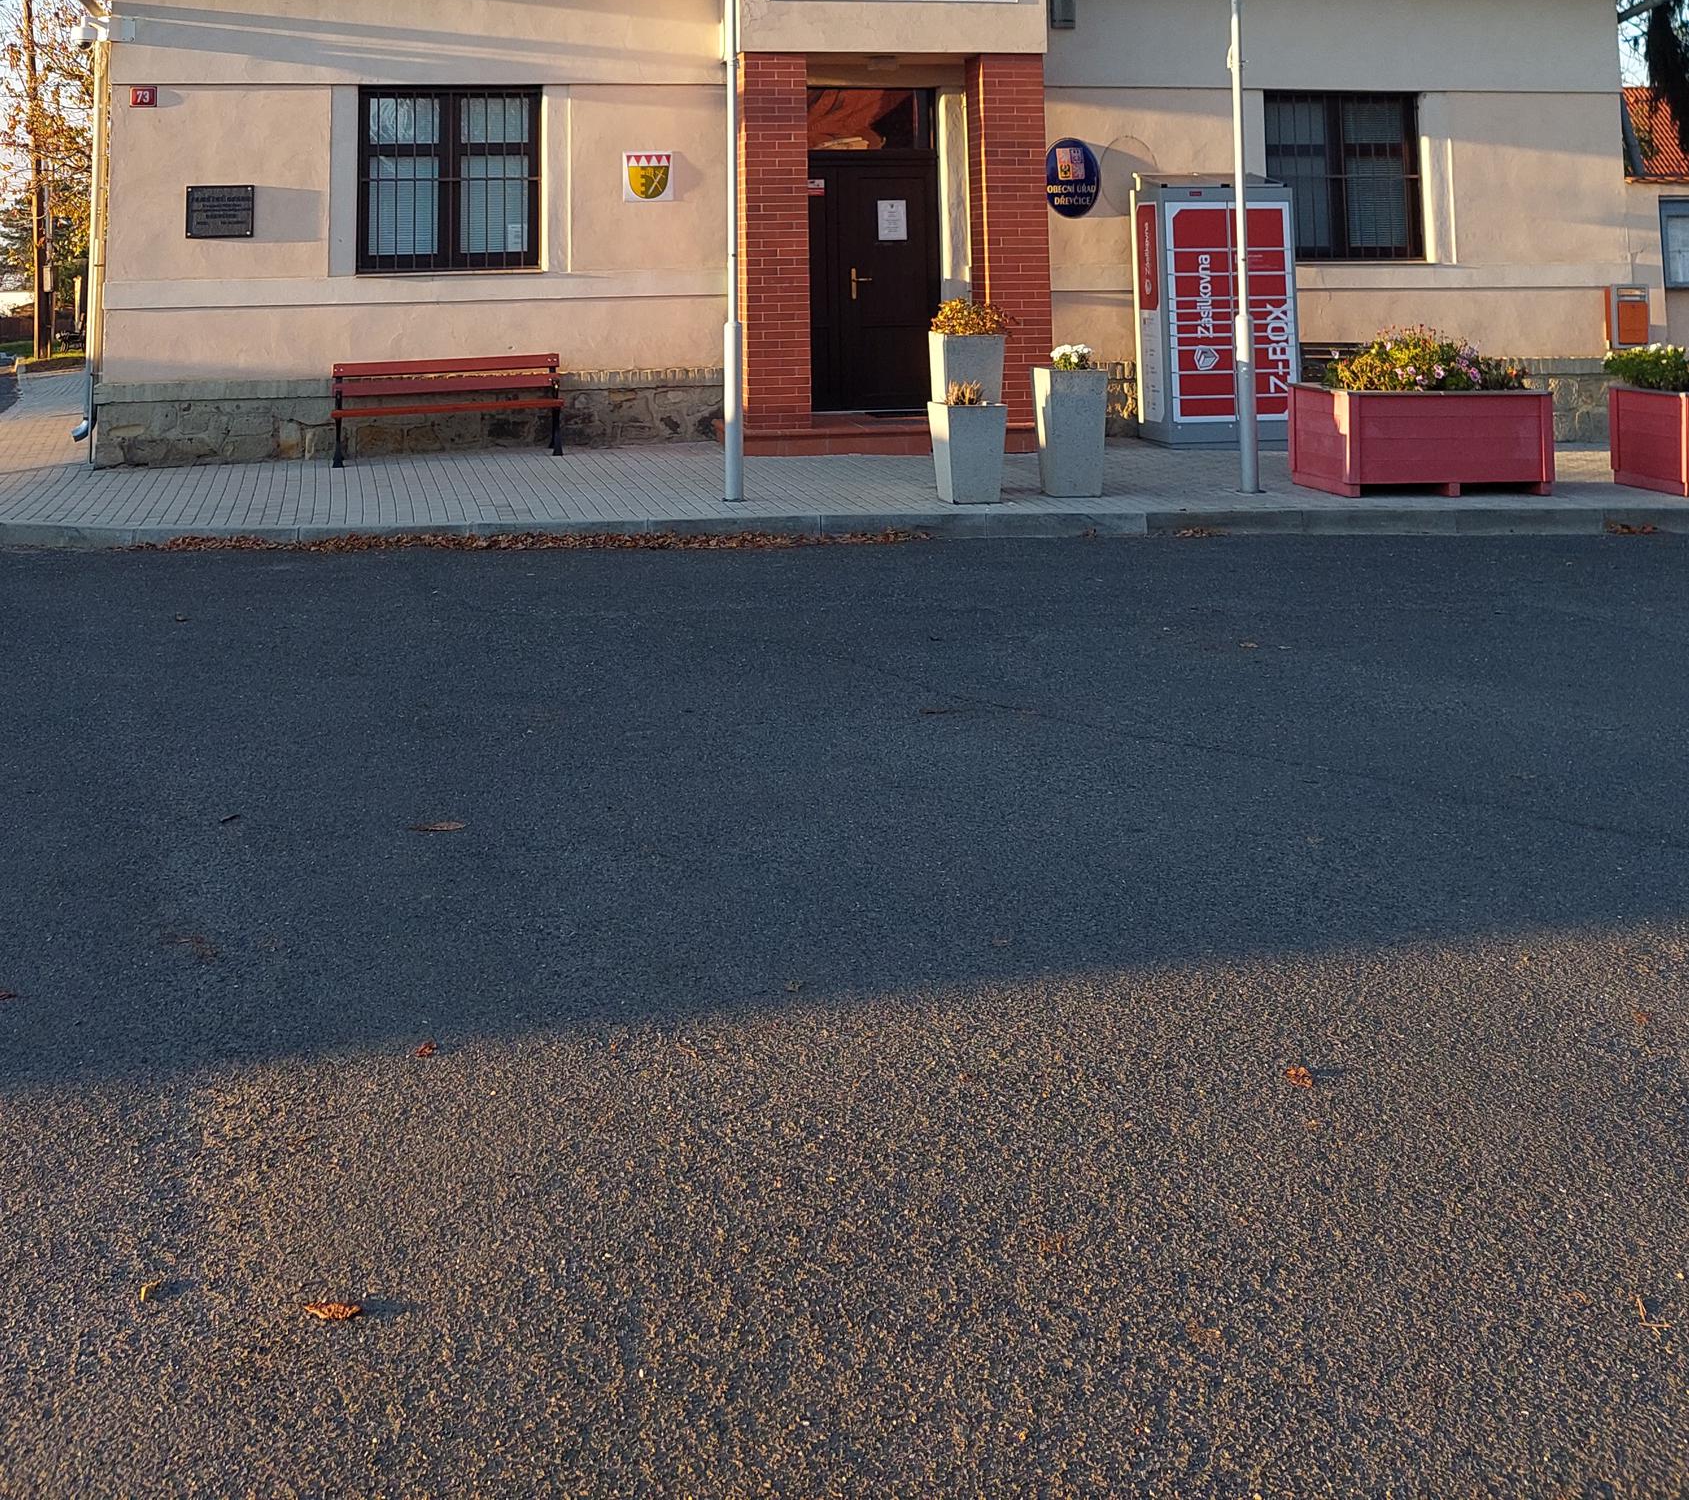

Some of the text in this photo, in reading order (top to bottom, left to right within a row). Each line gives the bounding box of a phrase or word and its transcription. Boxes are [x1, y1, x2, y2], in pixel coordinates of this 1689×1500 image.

[136, 90, 150, 103] 73
[1046, 182, 1096, 194] OBECNÍ ÚŘAD
[1054, 194, 1091, 205] DŘEVČICE
[1265, 302, 1290, 393] Z-BOX
